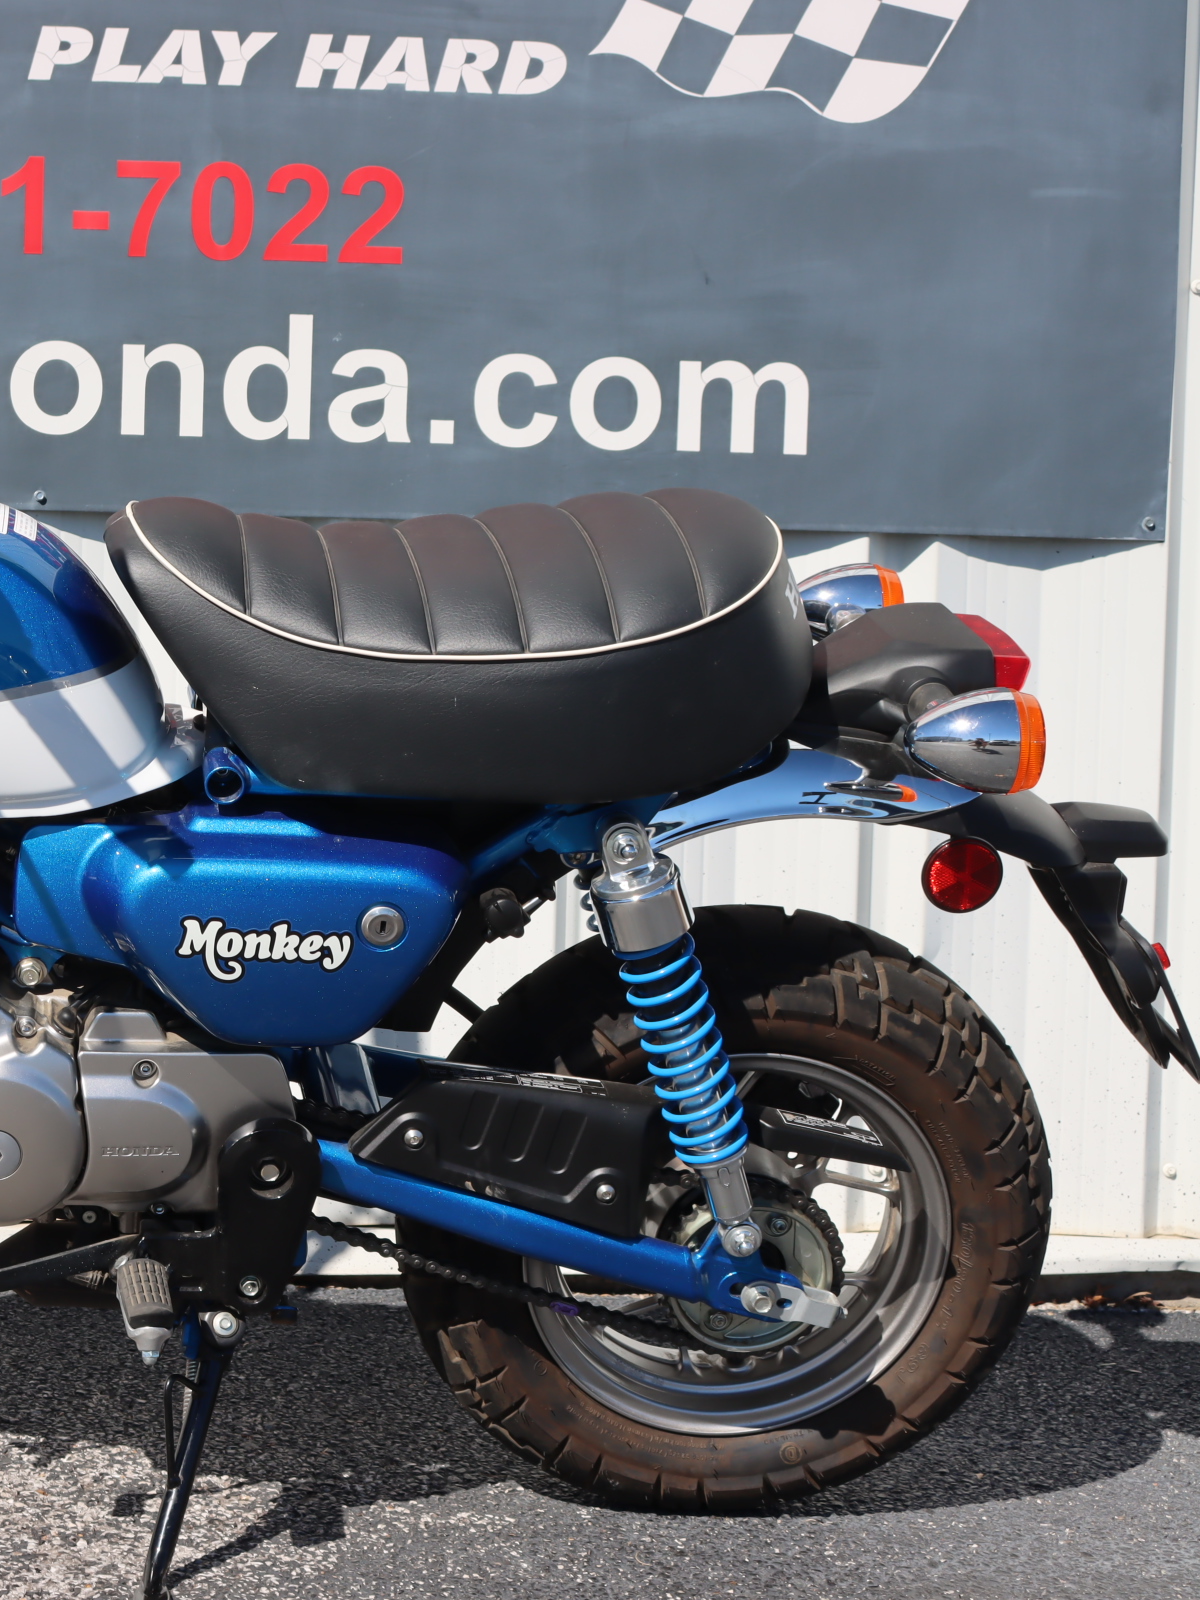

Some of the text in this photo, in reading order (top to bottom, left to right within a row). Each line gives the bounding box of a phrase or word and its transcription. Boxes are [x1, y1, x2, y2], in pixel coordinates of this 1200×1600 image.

[27, 25, 278, 87] PLAY
[295, 33, 568, 95] HARD
[177, 917, 353, 982] Monkey
[101, 1145, 180, 1157] HONDA
